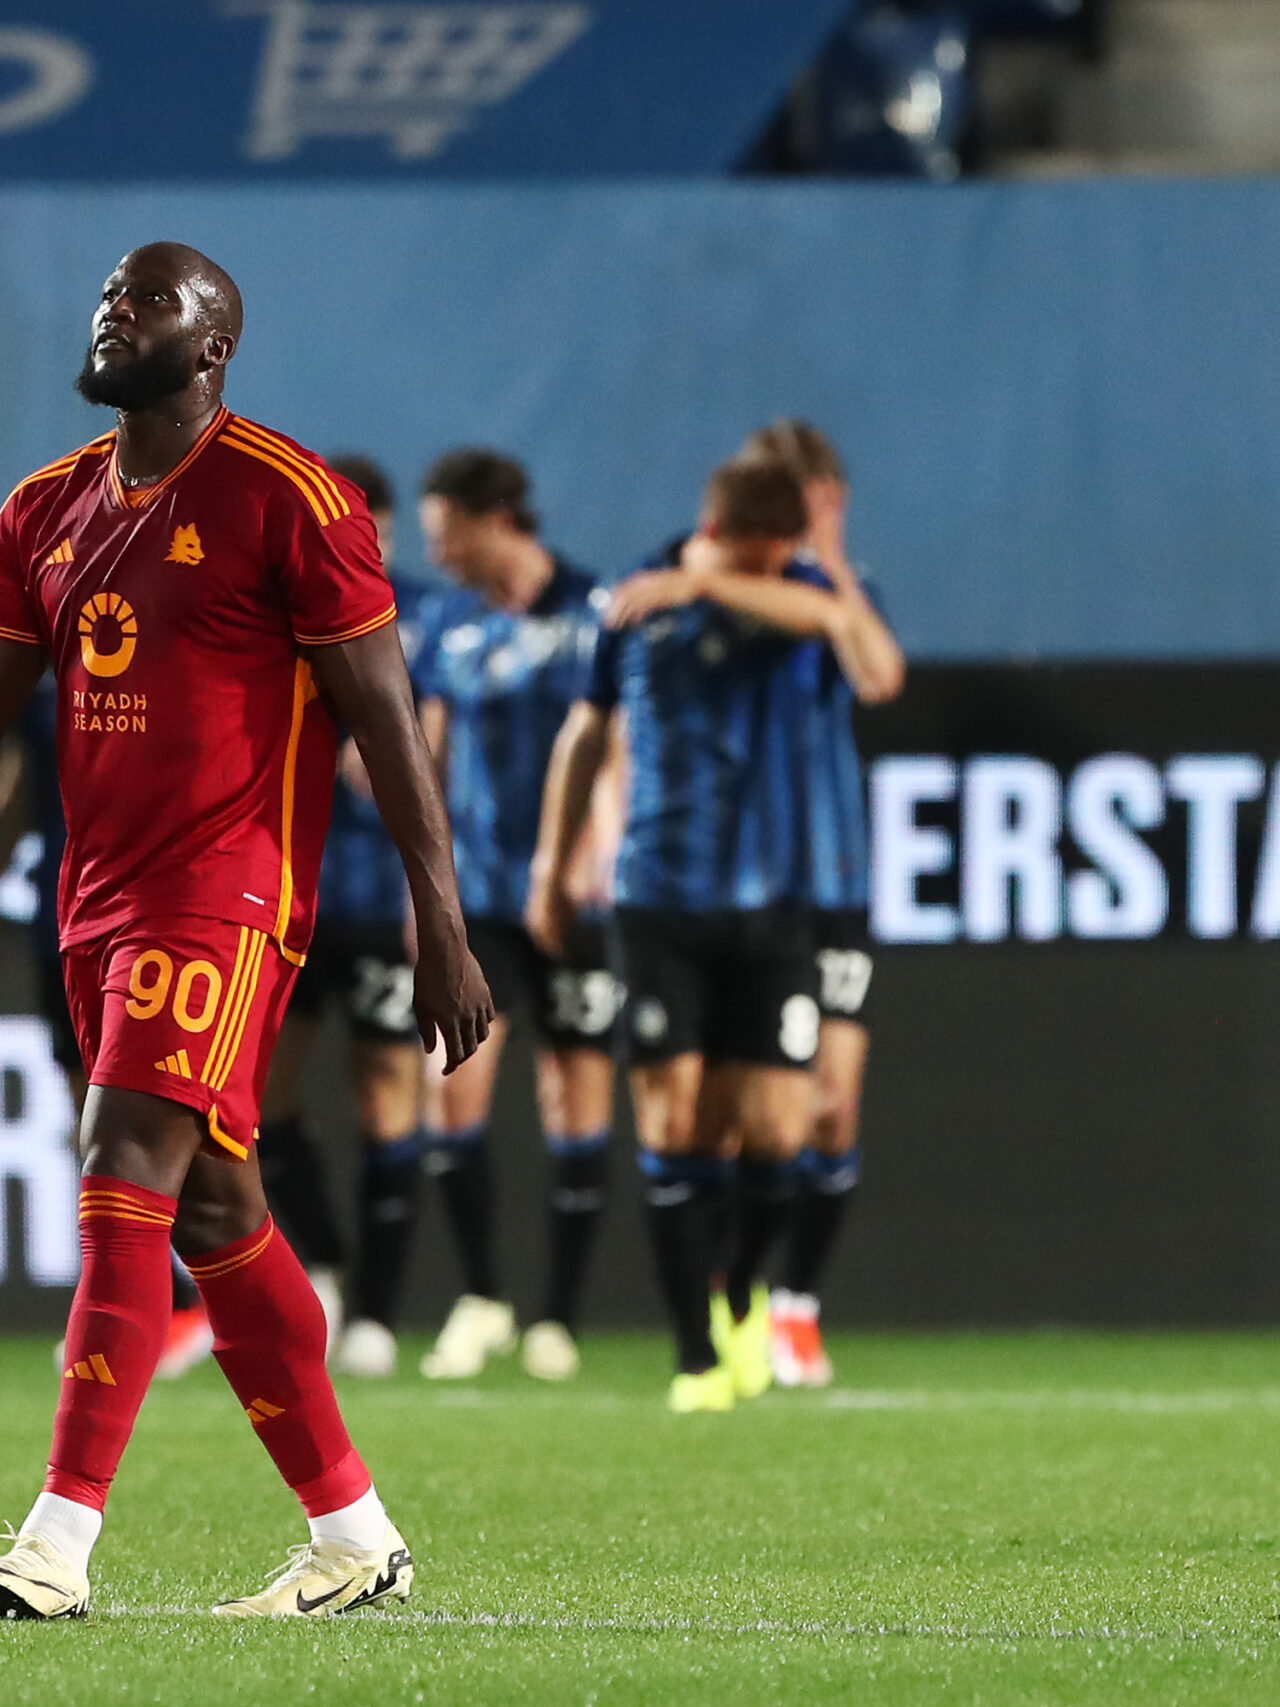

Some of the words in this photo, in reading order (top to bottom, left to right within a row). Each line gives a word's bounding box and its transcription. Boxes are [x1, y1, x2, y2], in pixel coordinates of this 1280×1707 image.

[73, 690, 147, 710] RIYADH
[74, 713, 146, 732] SEASON
[868, 751, 1280, 943] ERST
[125, 949, 222, 1033] 90
